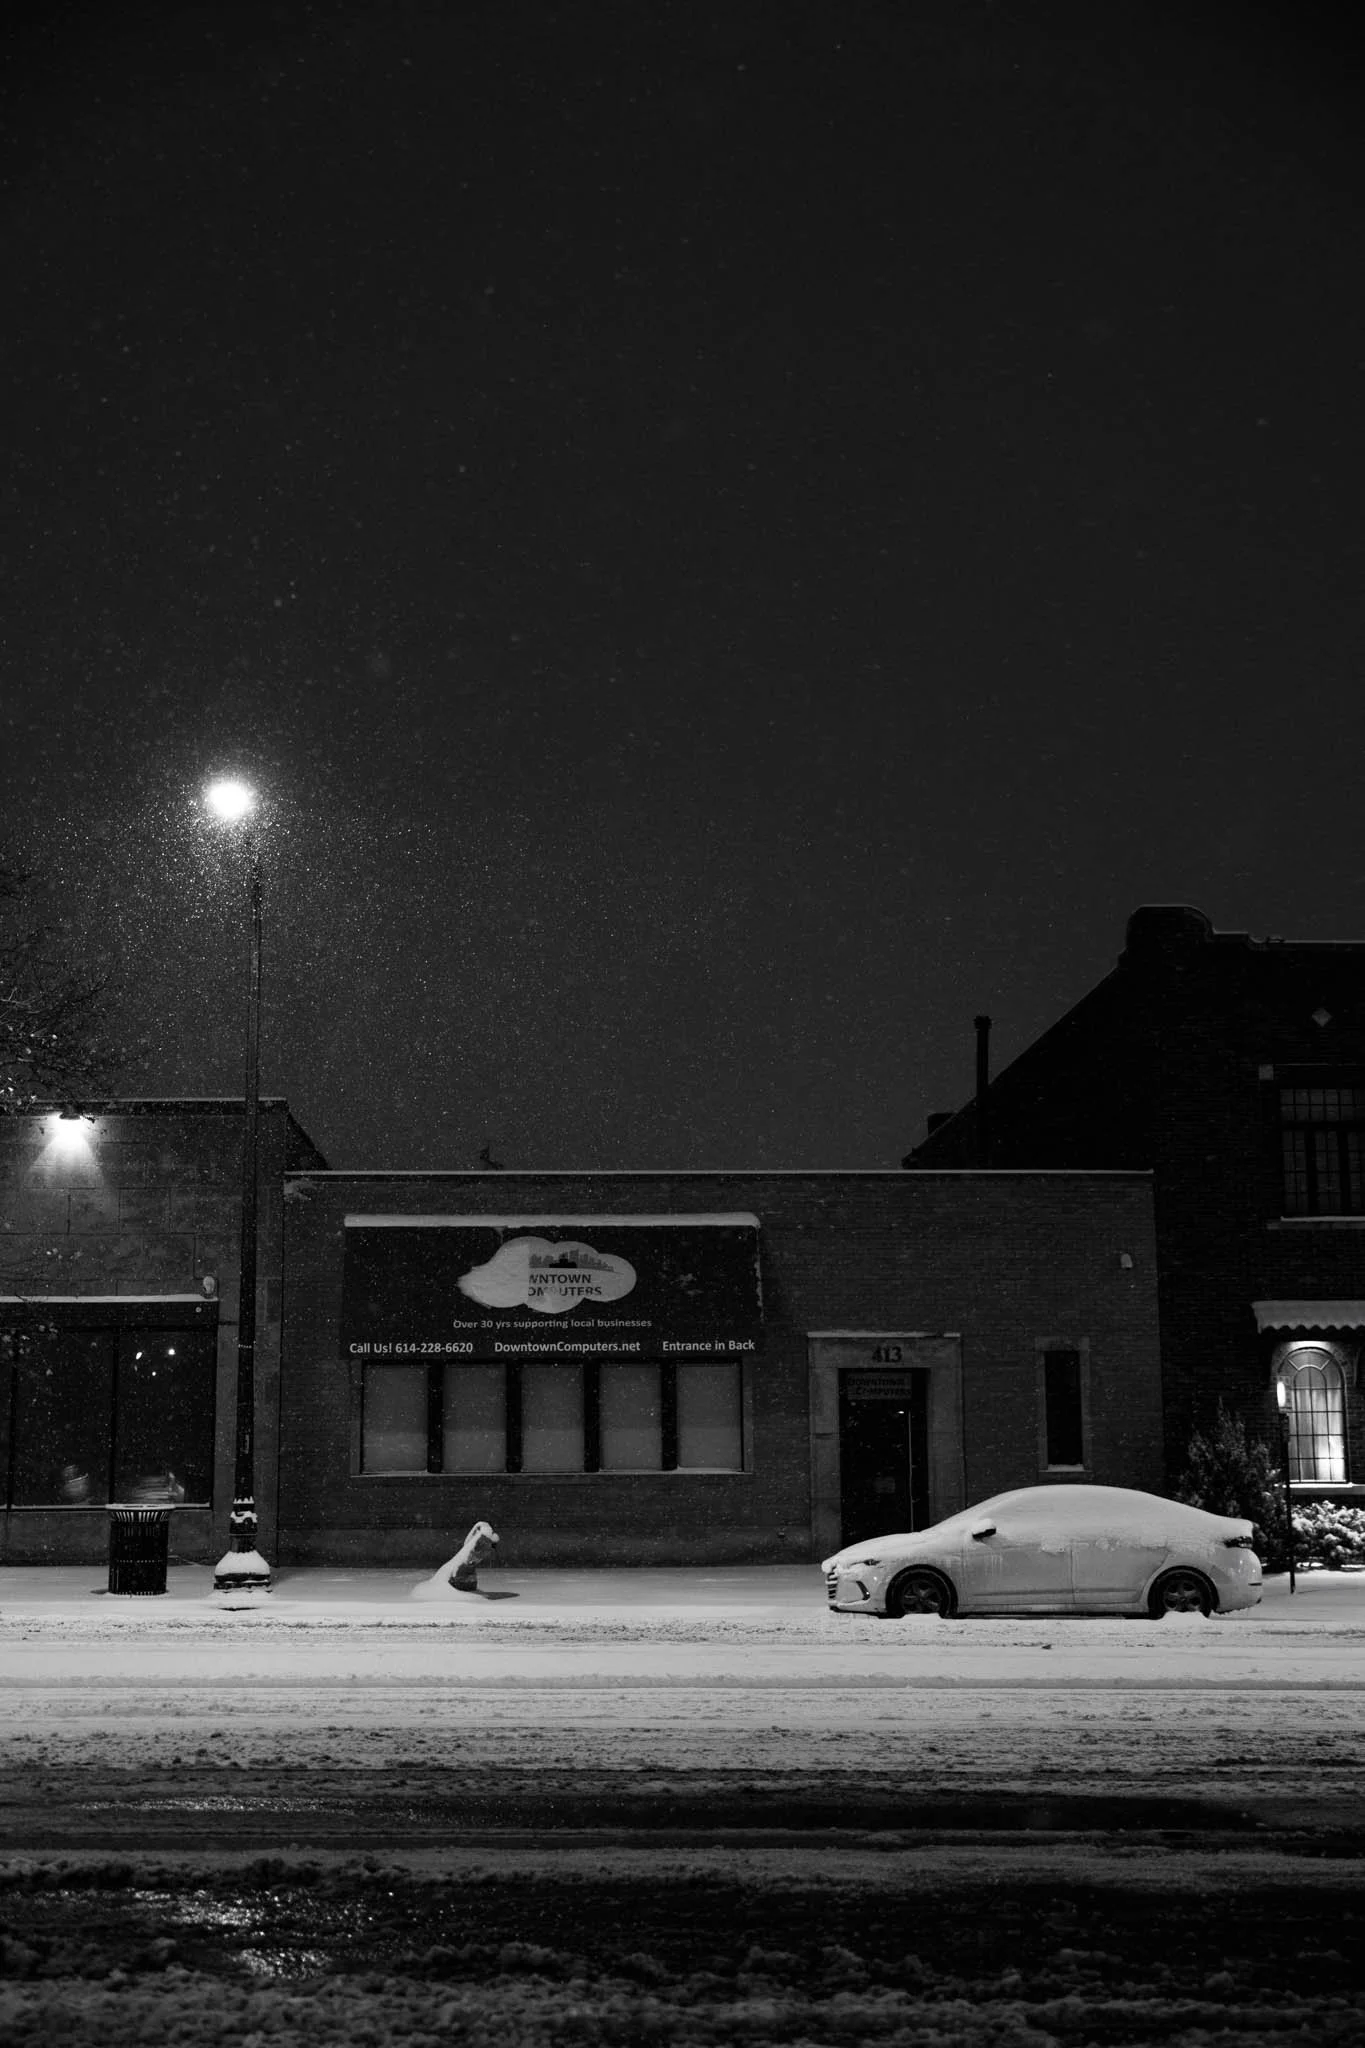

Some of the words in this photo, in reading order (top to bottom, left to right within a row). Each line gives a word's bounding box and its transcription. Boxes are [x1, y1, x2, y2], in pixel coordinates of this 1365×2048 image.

[528, 1274, 591, 1284] WNTOWN
[527, 1287, 602, 1297] OMUTERS
[453, 1320, 478, 1329] Over
[480, 1320, 493, 1328] 30
[495, 1321, 511, 1330] yrs
[513, 1319, 568, 1330] supporting
[571, 1318, 595, 1328] local
[597, 1318, 653, 1328] businesses
[349, 1342, 370, 1353] Call
[373, 1342, 392, 1353] Us!
[395, 1342, 473, 1353] 614-228-6620
[494, 1341, 641, 1353] DowntownComputers.net
[662, 1340, 711, 1351] Entrance
[714, 1340, 725, 1351] in
[728, 1339, 755, 1350] Back
[872, 1346, 902, 1362] 413
